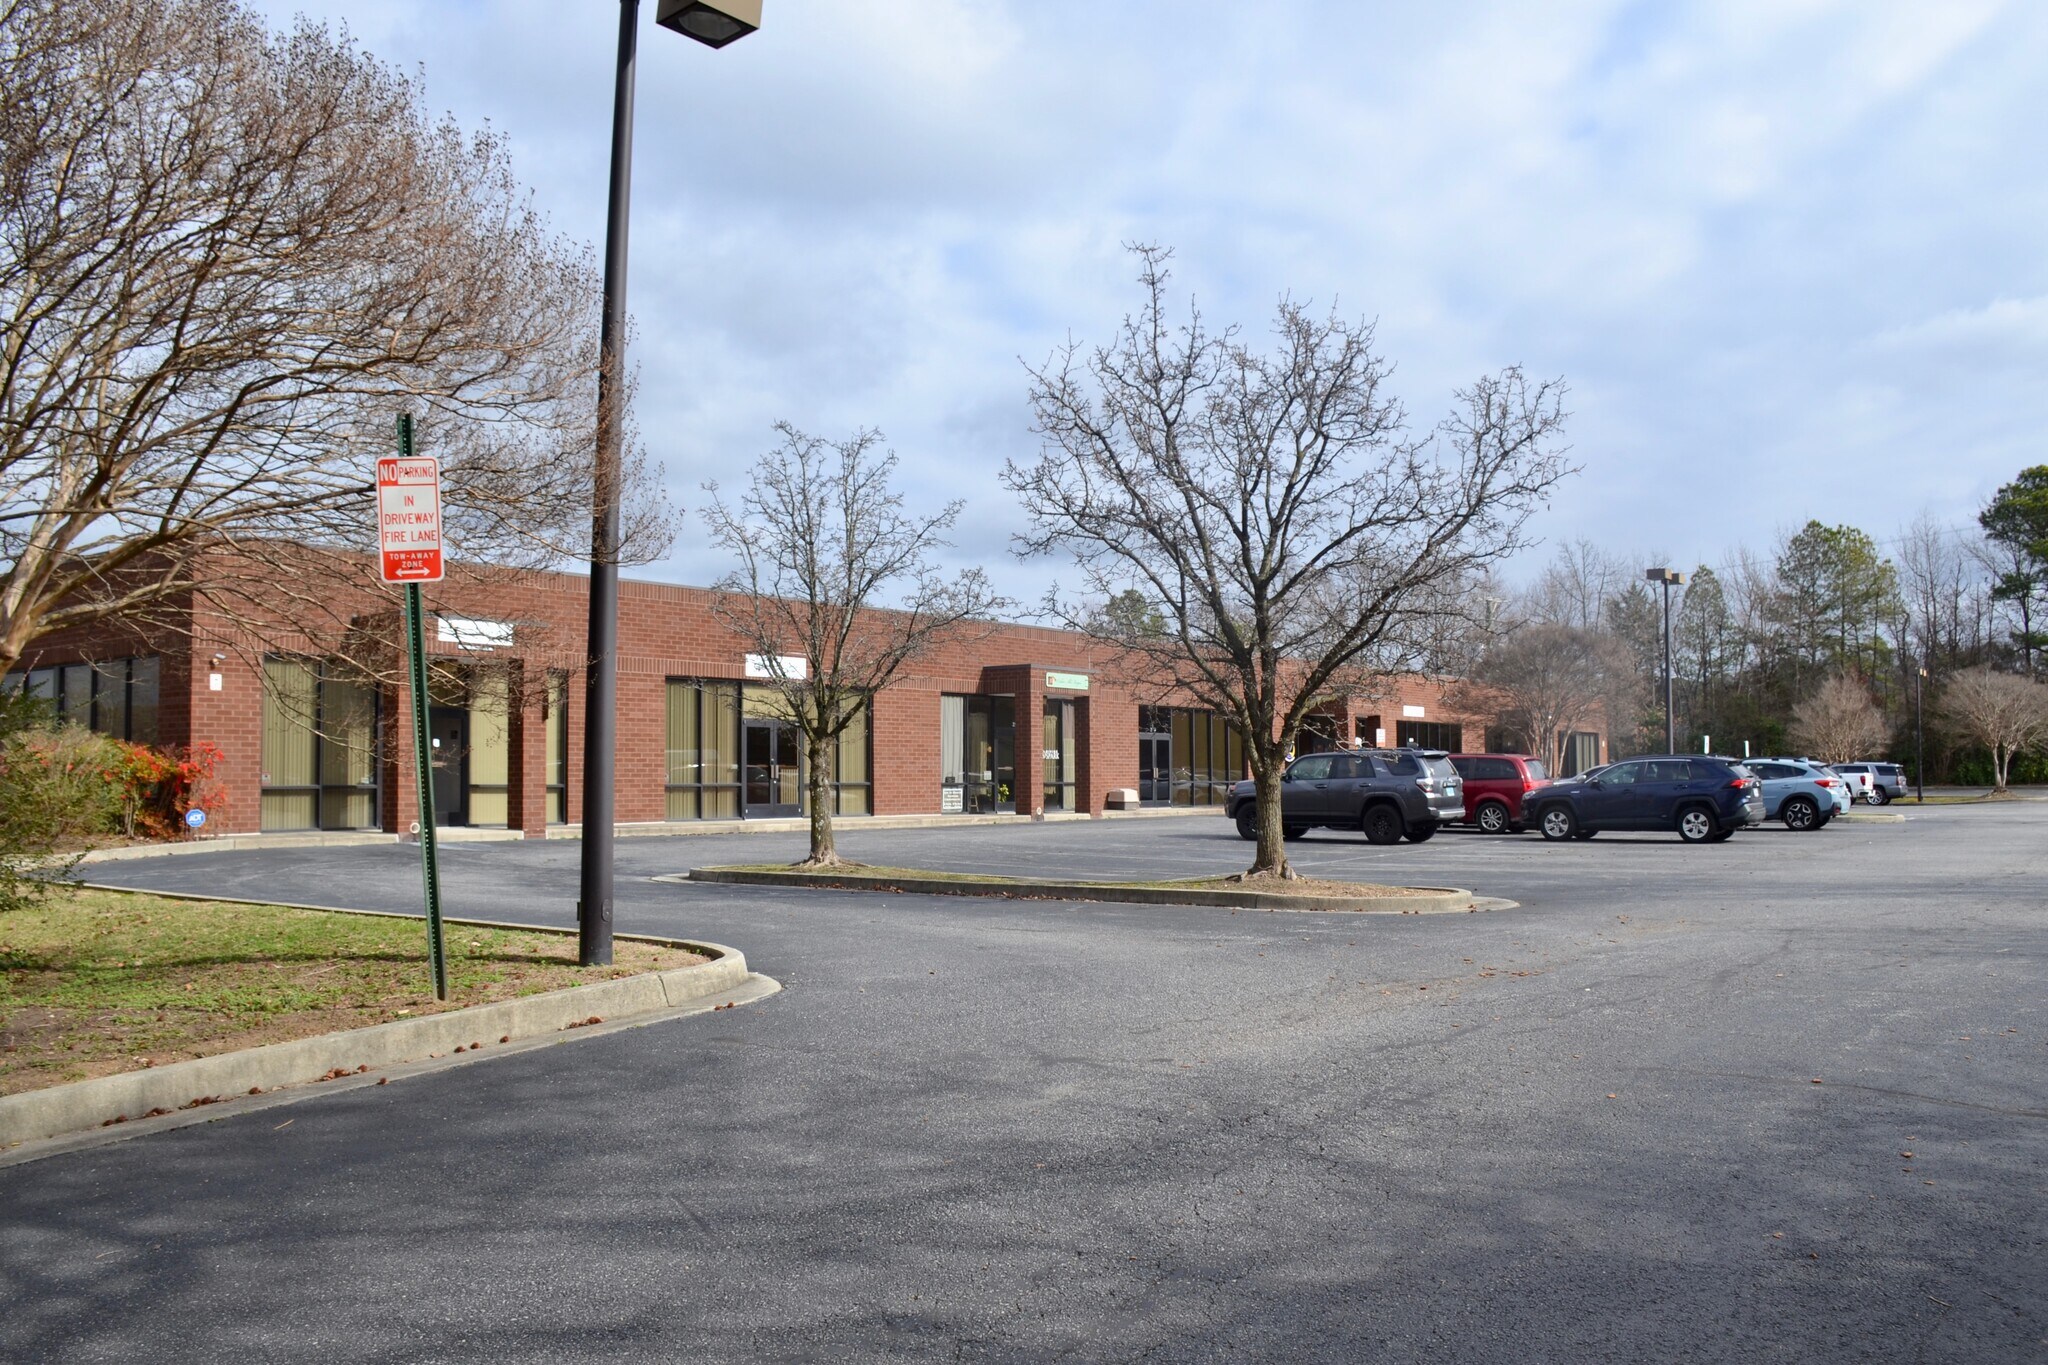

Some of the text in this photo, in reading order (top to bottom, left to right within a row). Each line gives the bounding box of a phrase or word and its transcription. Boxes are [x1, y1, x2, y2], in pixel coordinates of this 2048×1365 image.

[380, 463, 434, 482] NO PARKING
[404, 495, 415, 507] IN
[384, 512, 435, 525] DRIVEWAY
[384, 530, 437, 543] FIRE LANE
[389, 552, 435, 560] TOW-AWAY
[402, 560, 424, 568] ZONE
